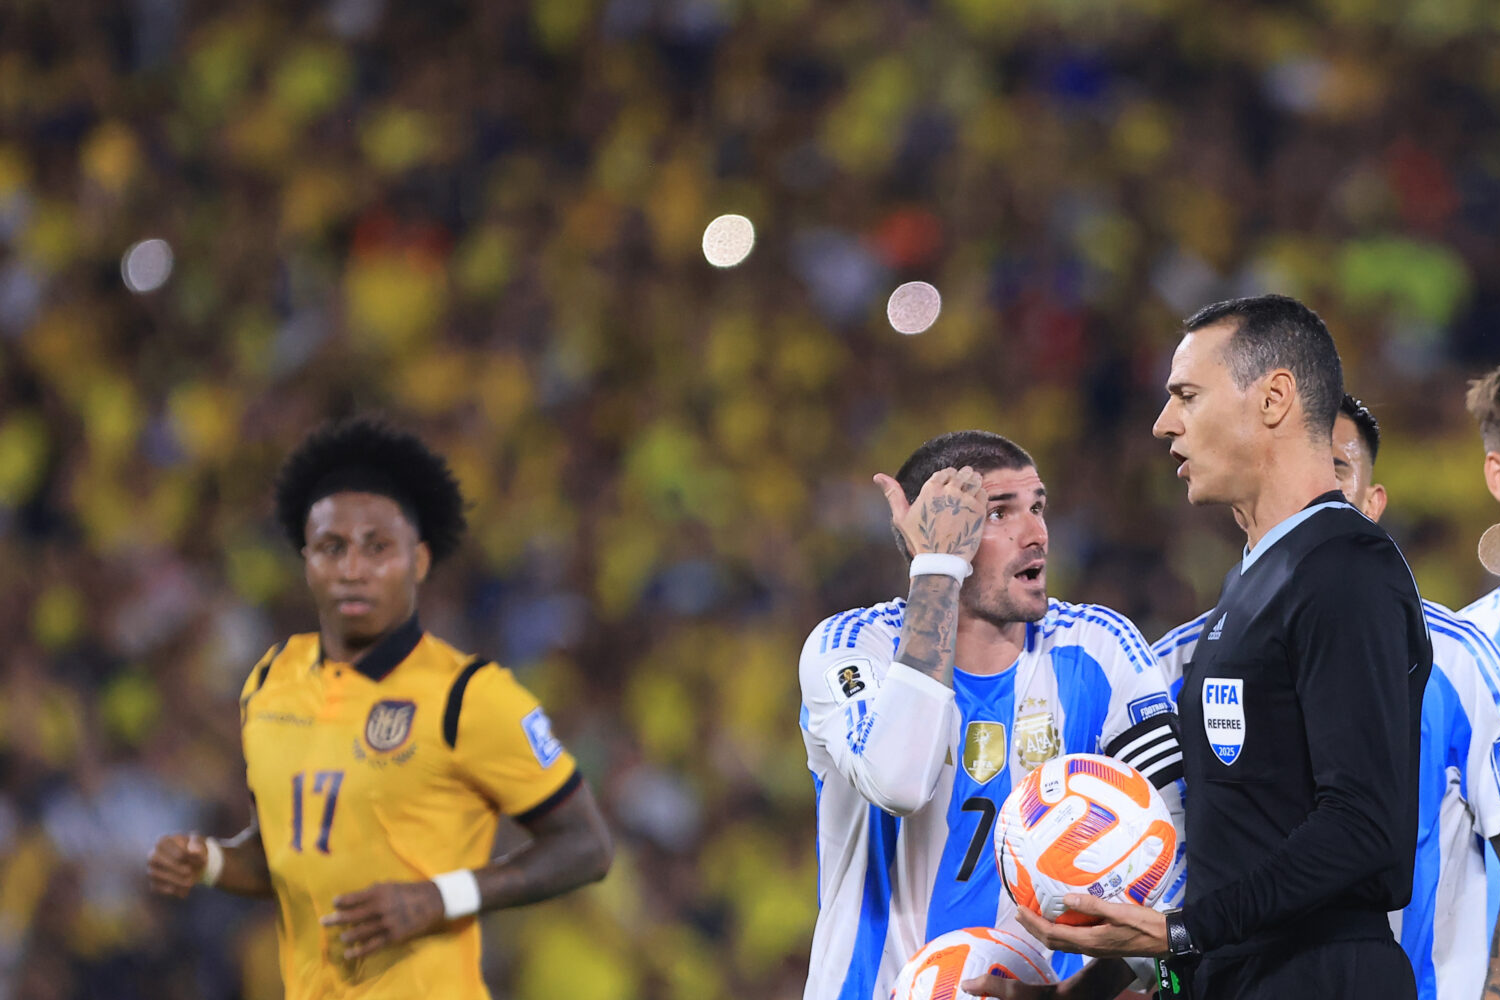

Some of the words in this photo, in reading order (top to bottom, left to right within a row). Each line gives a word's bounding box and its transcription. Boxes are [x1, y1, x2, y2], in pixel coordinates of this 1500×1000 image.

[1206, 685, 1238, 705] FIFA
[1207, 718, 1242, 730] REFEREE
[1218, 746, 1236, 758] 2025
[291, 769, 345, 855] 17
[956, 797, 996, 882] 7
